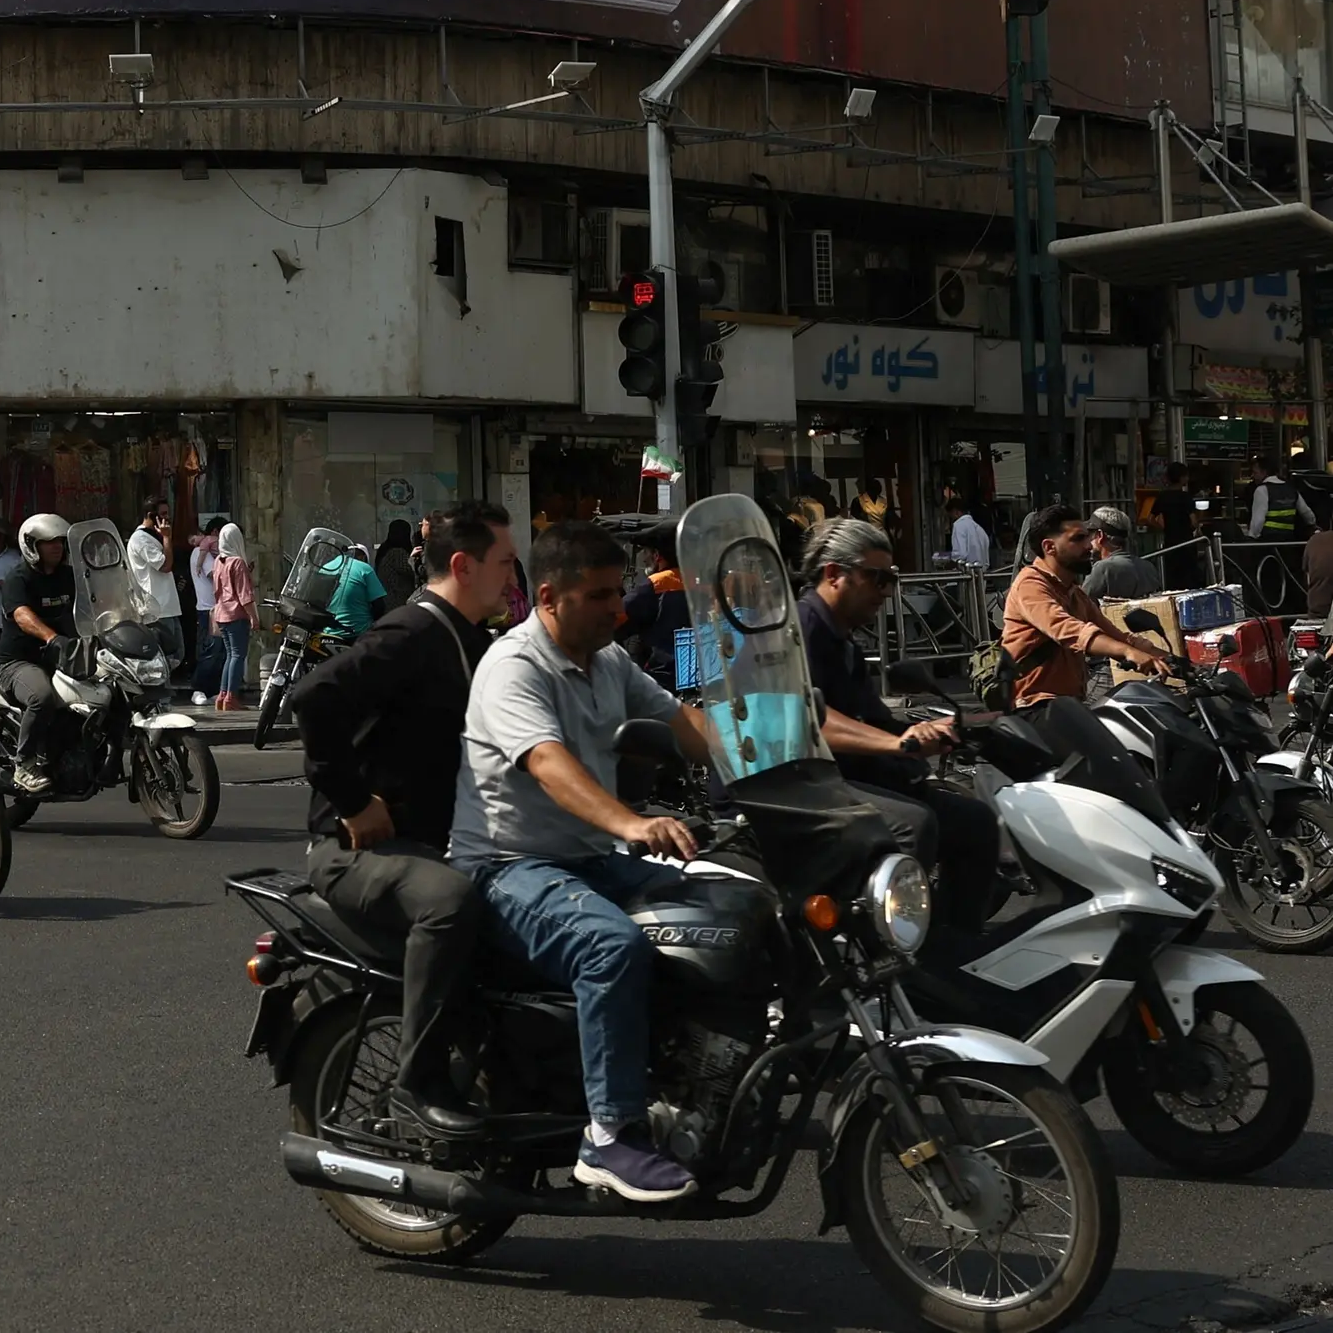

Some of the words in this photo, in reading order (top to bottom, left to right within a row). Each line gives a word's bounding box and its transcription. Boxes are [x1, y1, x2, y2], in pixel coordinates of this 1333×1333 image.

[821, 334, 860, 391] نور
[871, 335, 940, 393] کوه
[642, 926, 741, 945] BOXER
